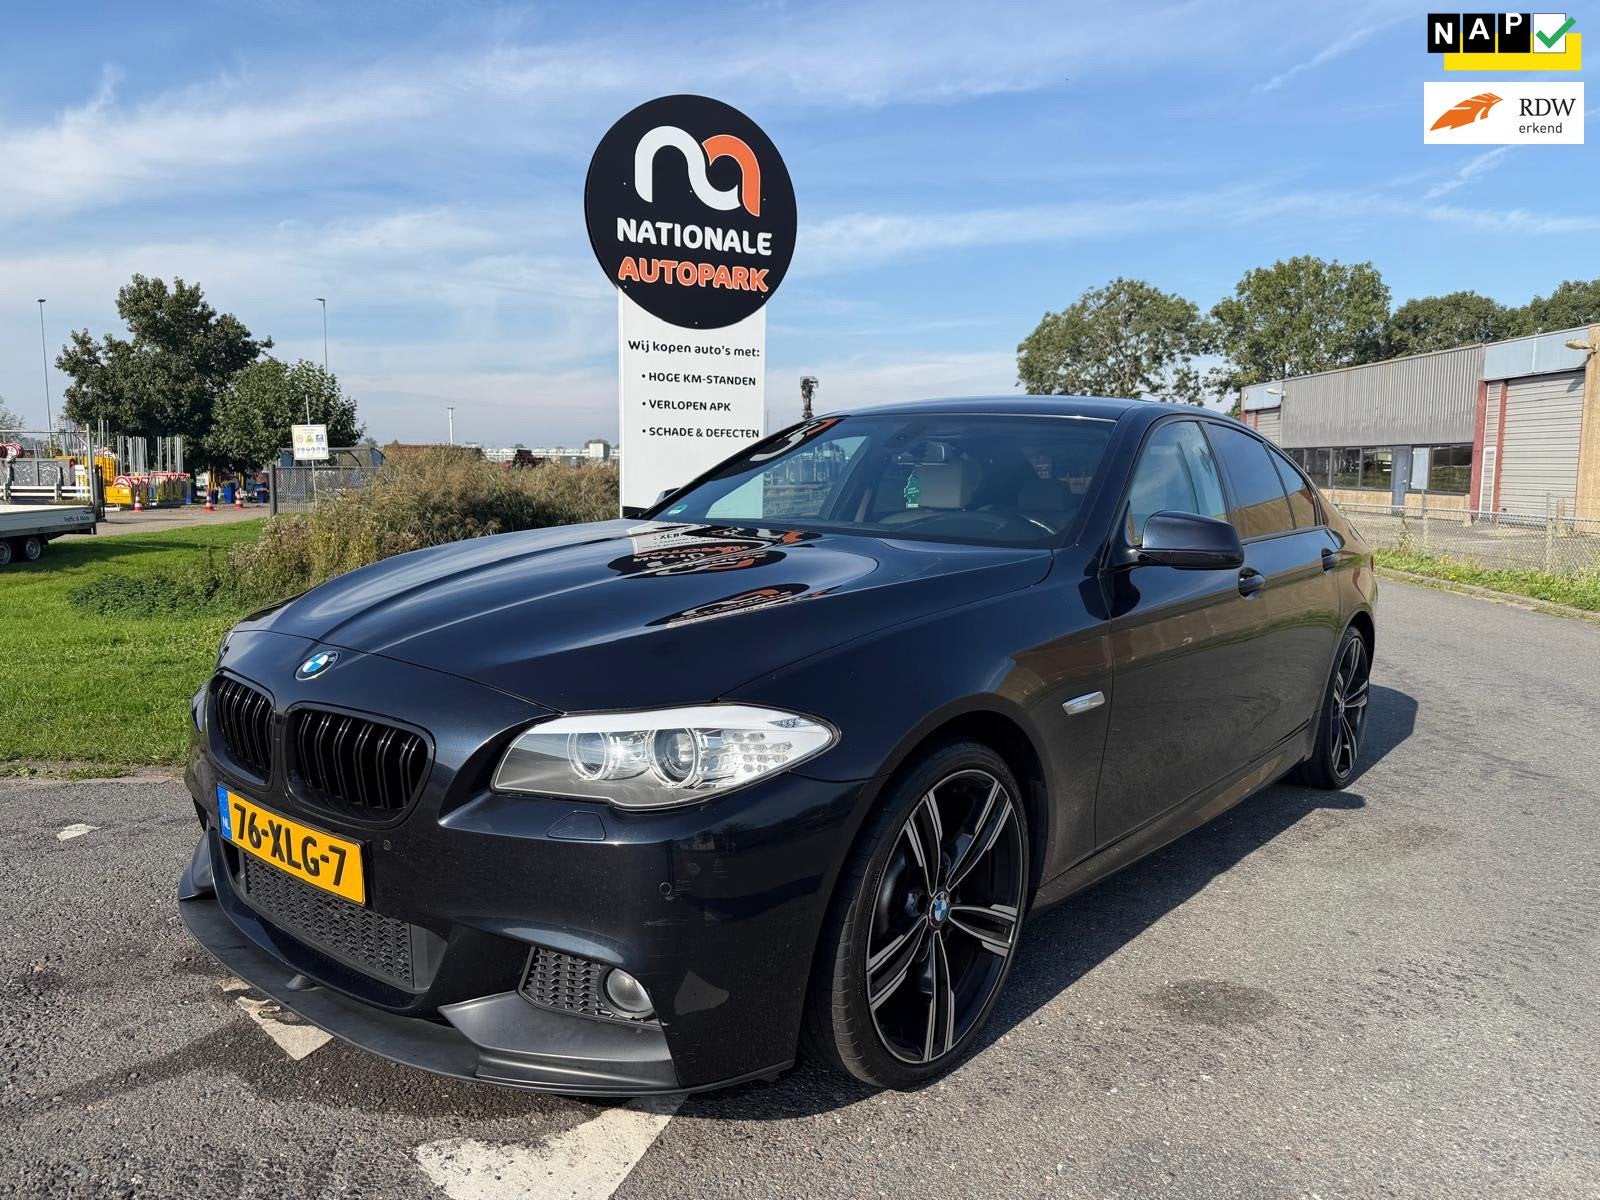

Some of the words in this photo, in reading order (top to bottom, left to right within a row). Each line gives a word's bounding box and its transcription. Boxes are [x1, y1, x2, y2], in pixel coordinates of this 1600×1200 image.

[616, 217, 773, 256] NATIONALE
[617, 256, 769, 293] AUTOPARK
[628, 340, 650, 353] Wij
[652, 341, 692, 354] kopen
[694, 344, 731, 356] auto's
[733, 347, 760, 357] met:
[648, 372, 681, 383] HOGE
[683, 373, 756, 386] KM-STANDEN
[648, 399, 707, 411] VERLOPEN
[709, 402, 731, 412] APK
[648, 426, 694, 437] SCHADE
[695, 427, 704, 438] &
[705, 428, 760, 439] DEFECTEN
[233, 802, 347, 887] 76-XLG-7
